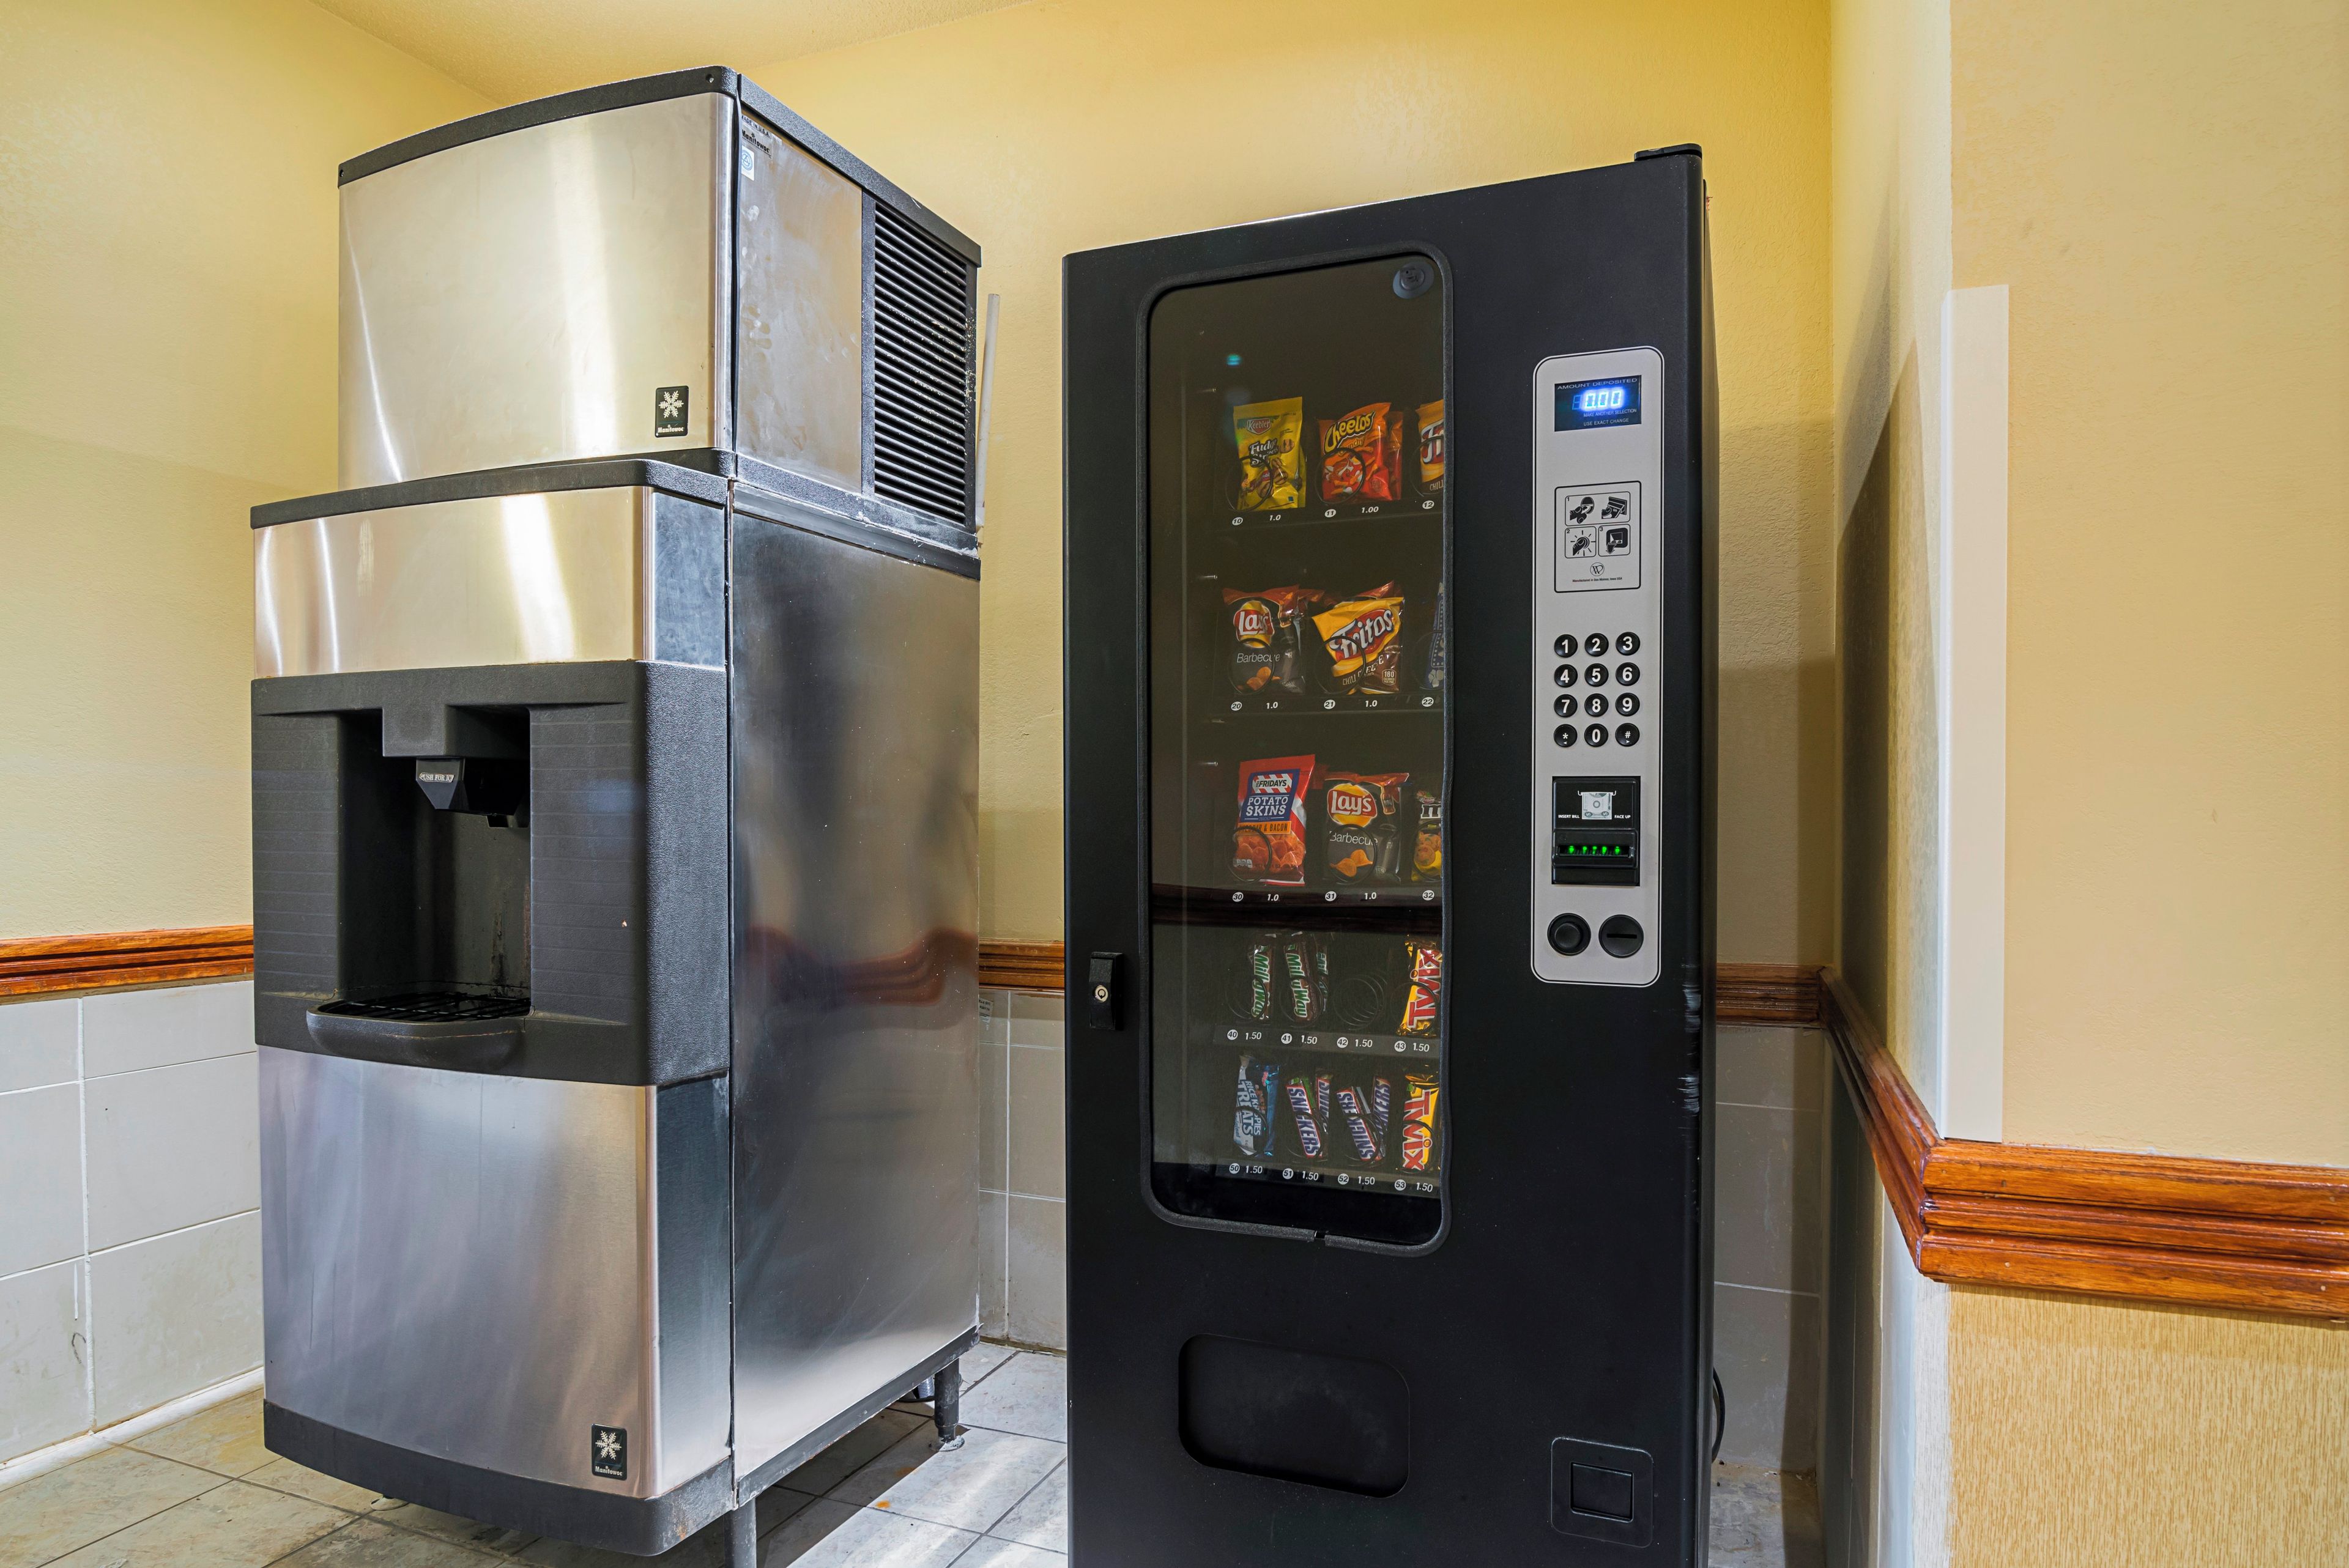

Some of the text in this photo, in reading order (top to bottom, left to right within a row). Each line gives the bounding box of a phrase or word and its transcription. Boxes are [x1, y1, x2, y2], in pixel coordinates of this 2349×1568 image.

[741, 129, 770, 153] Manitowoc
[1592, 378, 1638, 386] DEPOSITED
[1584, 390, 1622, 409] 0.00
[1248, 420, 1271, 431] Keebler
[1324, 413, 1375, 453] Cheetos
[1239, 610, 1269, 635] Las
[1329, 609, 1393, 659] Fritos
[1561, 639, 1568, 654] 1
[1592, 638, 1601, 652] 2
[1622, 636, 1633, 651] 3
[1236, 652, 1280, 664] Barbecue
[1560, 669, 1570, 683] 4
[1591, 668, 1601, 682] 5
[1622, 667, 1633, 681] 6
[1561, 699, 1570, 713] 7
[1592, 698, 1601, 713] 8
[1622, 697, 1633, 712] 9
[1592, 728, 1601, 743] 0
[1247, 796, 1288, 805] POTATO
[1331, 790, 1371, 815] Lay's
[1245, 805, 1286, 816] SKINS
[1269, 823, 1288, 832] BACON
[1364, 892, 1376, 900] 1.0
[1286, 953, 1310, 1018] Mily Way
[1245, 1032, 1262, 1040] 1.50
[1301, 1035, 1318, 1045] 1.50
[1355, 1039, 1373, 1048] 1.50
[1412, 1043, 1430, 1052] 1.50
[1245, 1080, 1263, 1136] RICE KPIES
[1245, 1165, 1263, 1174] 1.50
[1302, 1170, 1319, 1180] 1.50
[1358, 1176, 1375, 1185] 1.50
[1416, 1182, 1433, 1192] 1.50
[595, 1465, 623, 1476] Manitowoc
